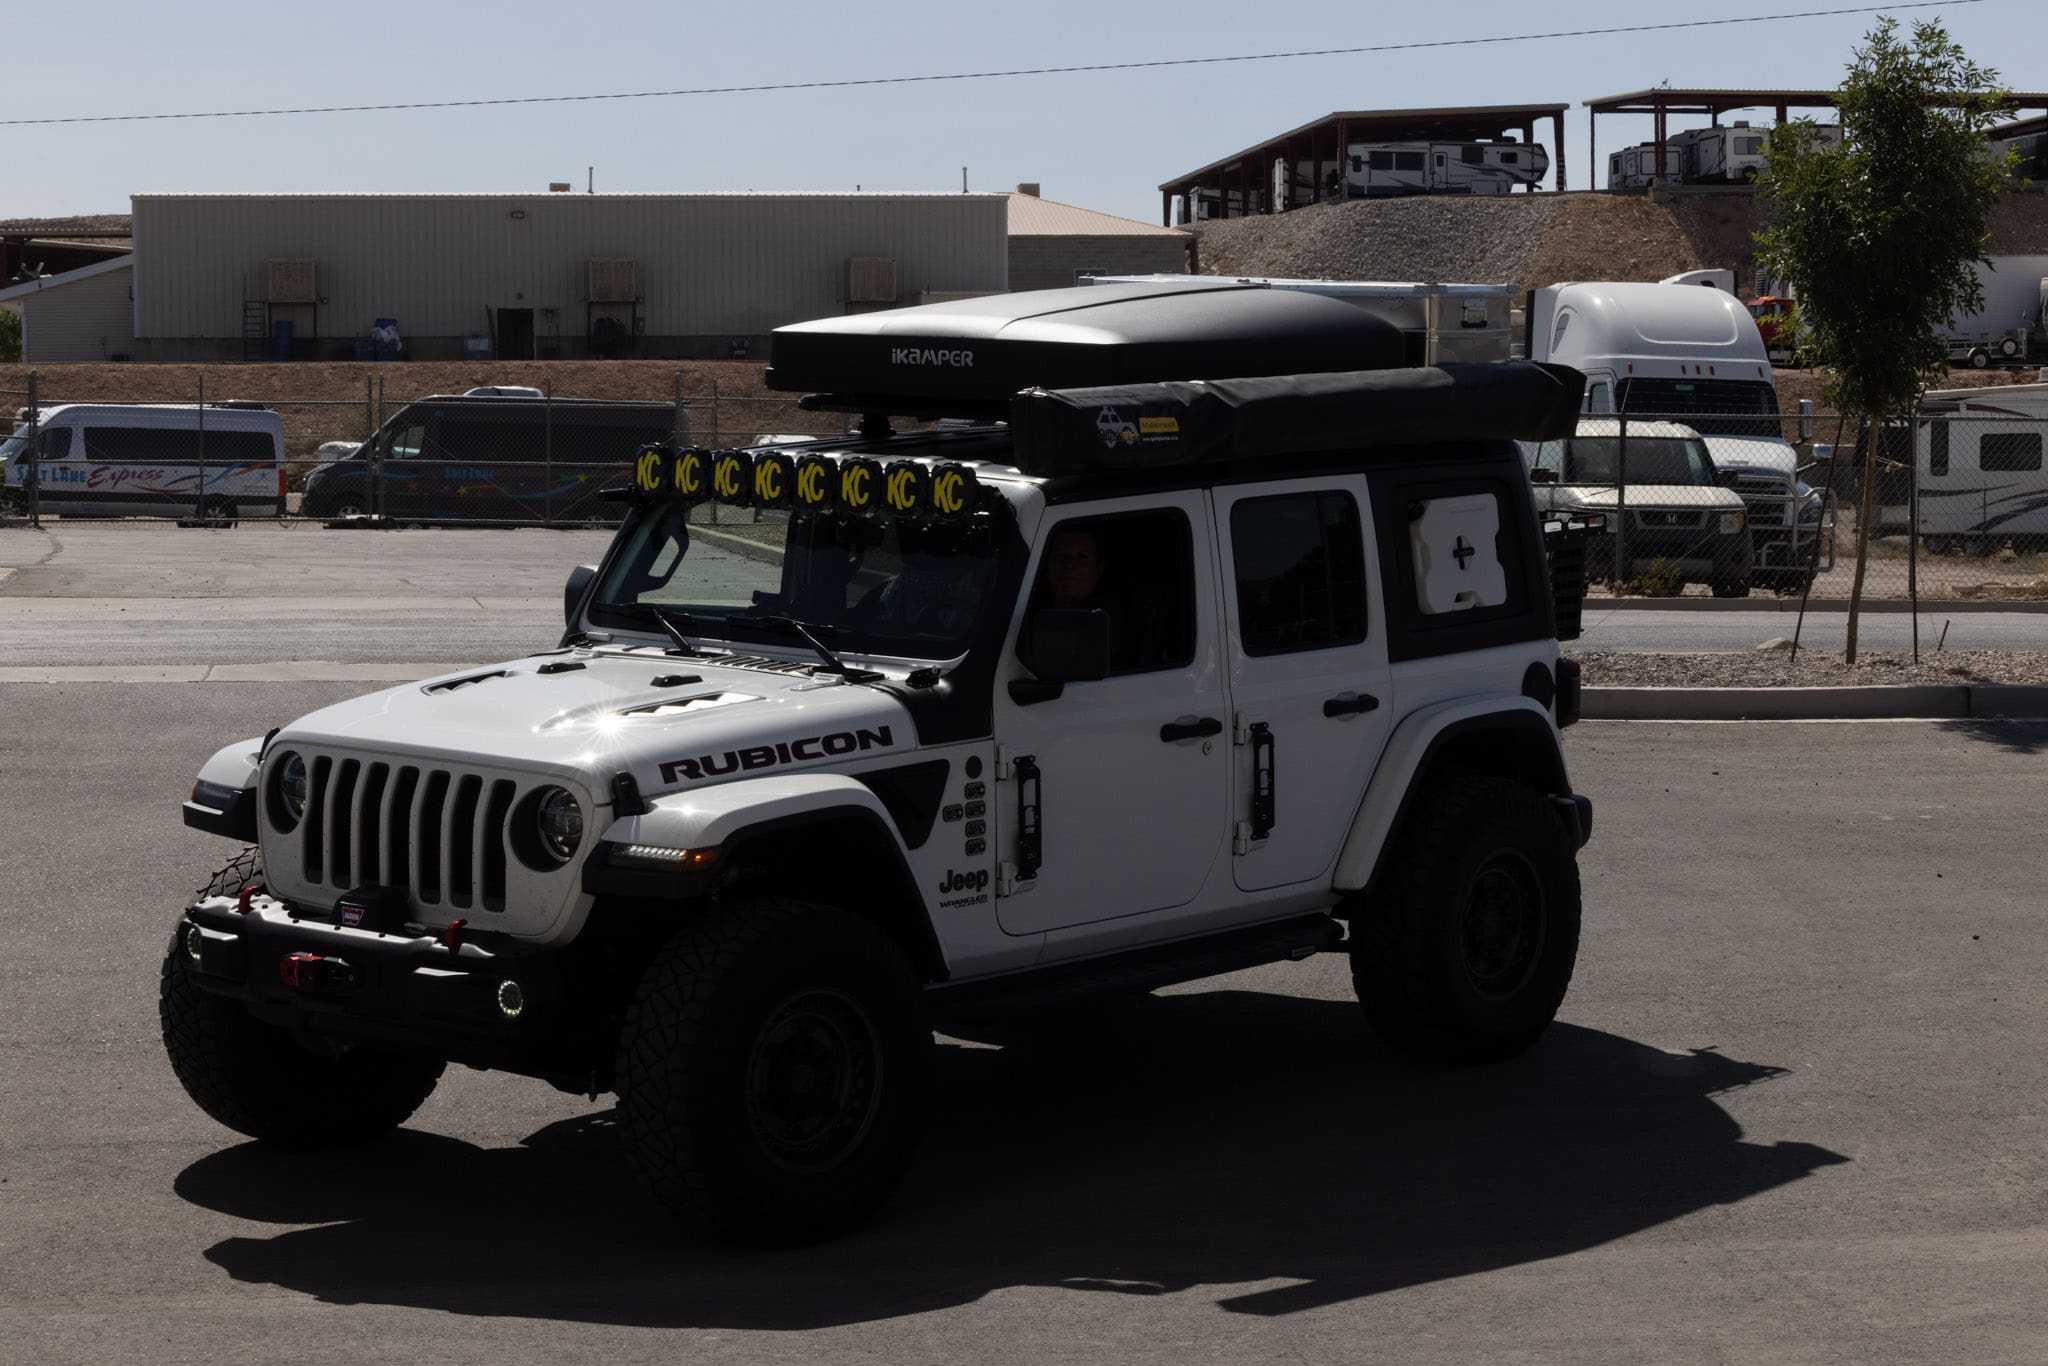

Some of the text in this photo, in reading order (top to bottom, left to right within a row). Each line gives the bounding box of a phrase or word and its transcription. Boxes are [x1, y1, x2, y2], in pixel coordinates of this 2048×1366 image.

[87, 466, 164, 489] Express
[638, 453, 659, 489] KC
[676, 455, 698, 492] KC
[715, 458, 739, 496] KC
[756, 460, 781, 499] KC
[798, 464, 824, 502] KC
[842, 466, 868, 506] KC
[888, 468, 915, 509] KC
[935, 472, 963, 512] KC
[659, 725, 893, 784] RUBICON
[939, 869, 989, 894] Jeep
